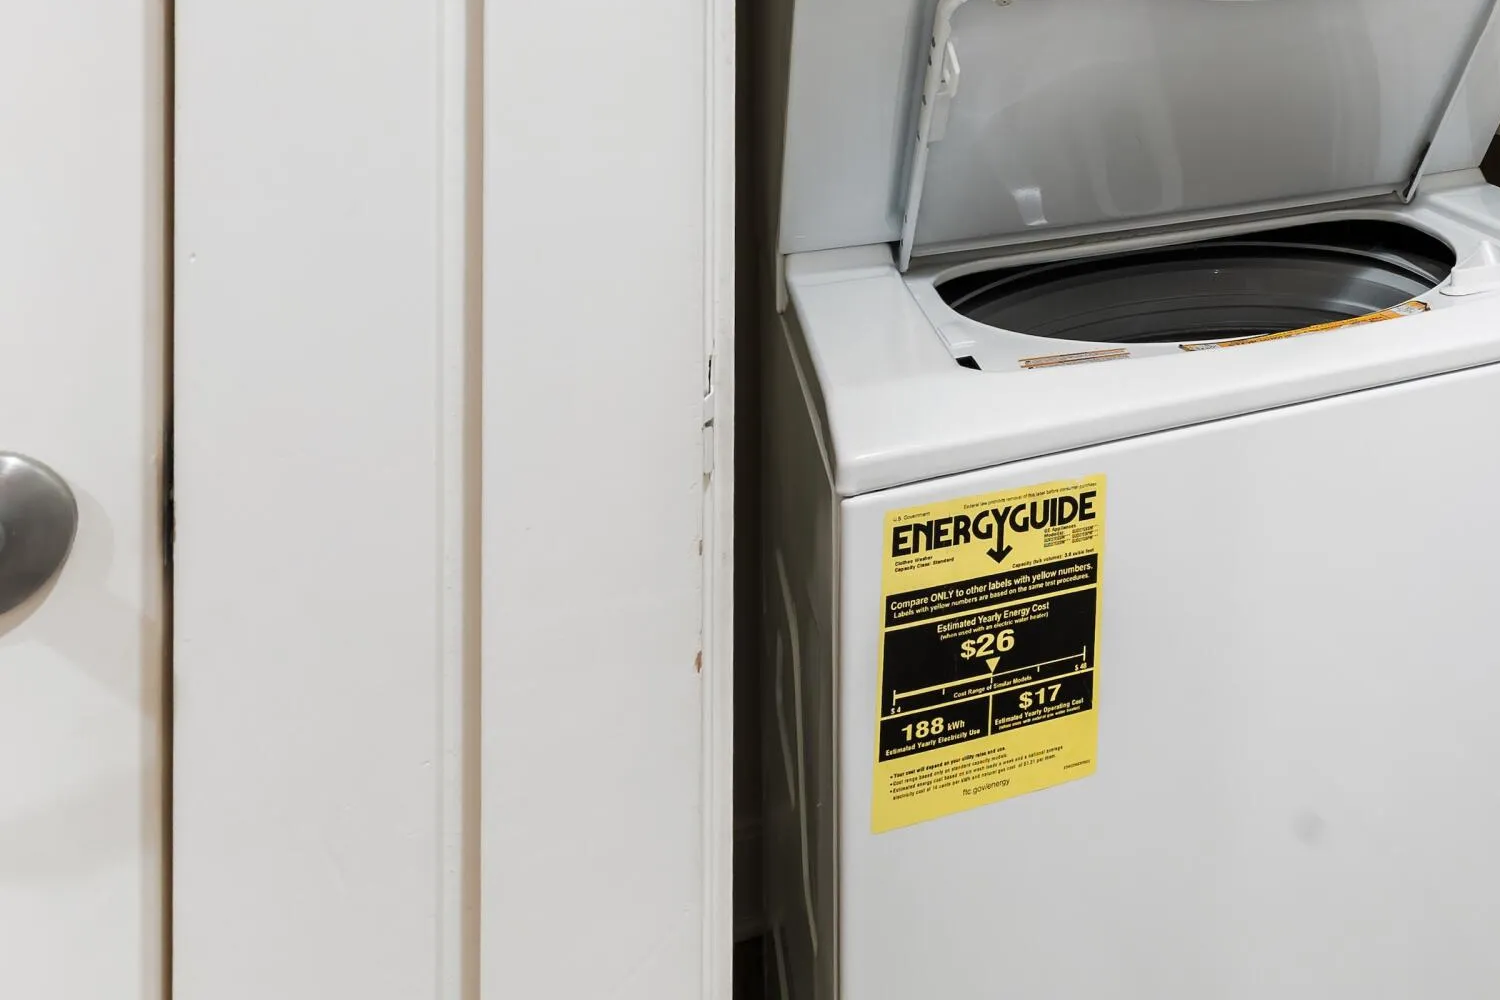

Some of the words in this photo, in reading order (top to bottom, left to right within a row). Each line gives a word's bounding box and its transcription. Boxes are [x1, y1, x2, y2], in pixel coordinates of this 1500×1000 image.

[892, 490, 1097, 558] ENERGYGUIDE
[890, 596, 928, 610] Compare
[930, 590, 954, 602] ONLY
[956, 588, 964, 597] to
[966, 584, 987, 594] other
[988, 578, 1012, 590] labels
[1014, 574, 1030, 584] with
[1032, 570, 1057, 583] yellow
[1058, 563, 1093, 575] numbers.
[894, 610, 914, 618] Labels
[916, 606, 929, 614] with
[930, 602, 950, 612] yellow
[951, 596, 978, 606] numbers
[990, 590, 1008, 598] based
[936, 617, 976, 633] Estimated
[978, 612, 1002, 624] Yearly
[1004, 606, 1030, 618] Energy
[1032, 602, 1050, 612] Cost
[940, 632, 958, 640] (when
[958, 628, 972, 636] used
[994, 620, 1013, 628] electric
[960, 628, 1015, 660] $26
[968, 687, 985, 696] Range
[994, 680, 1012, 688] Similar
[1012, 676, 1032, 684] Models
[1018, 684, 1062, 710] $17
[994, 713, 1023, 726] Estimated
[1024, 709, 1042, 718] Yearly
[1044, 702, 1070, 713] Operating
[1072, 698, 1084, 706] Cost
[886, 744, 916, 756] Estimated
[918, 739, 936, 748] Yearly
[938, 731, 968, 744] Electricity
[969, 728, 980, 736] Use
[902, 717, 944, 742] 188
[948, 720, 966, 731] kWh
